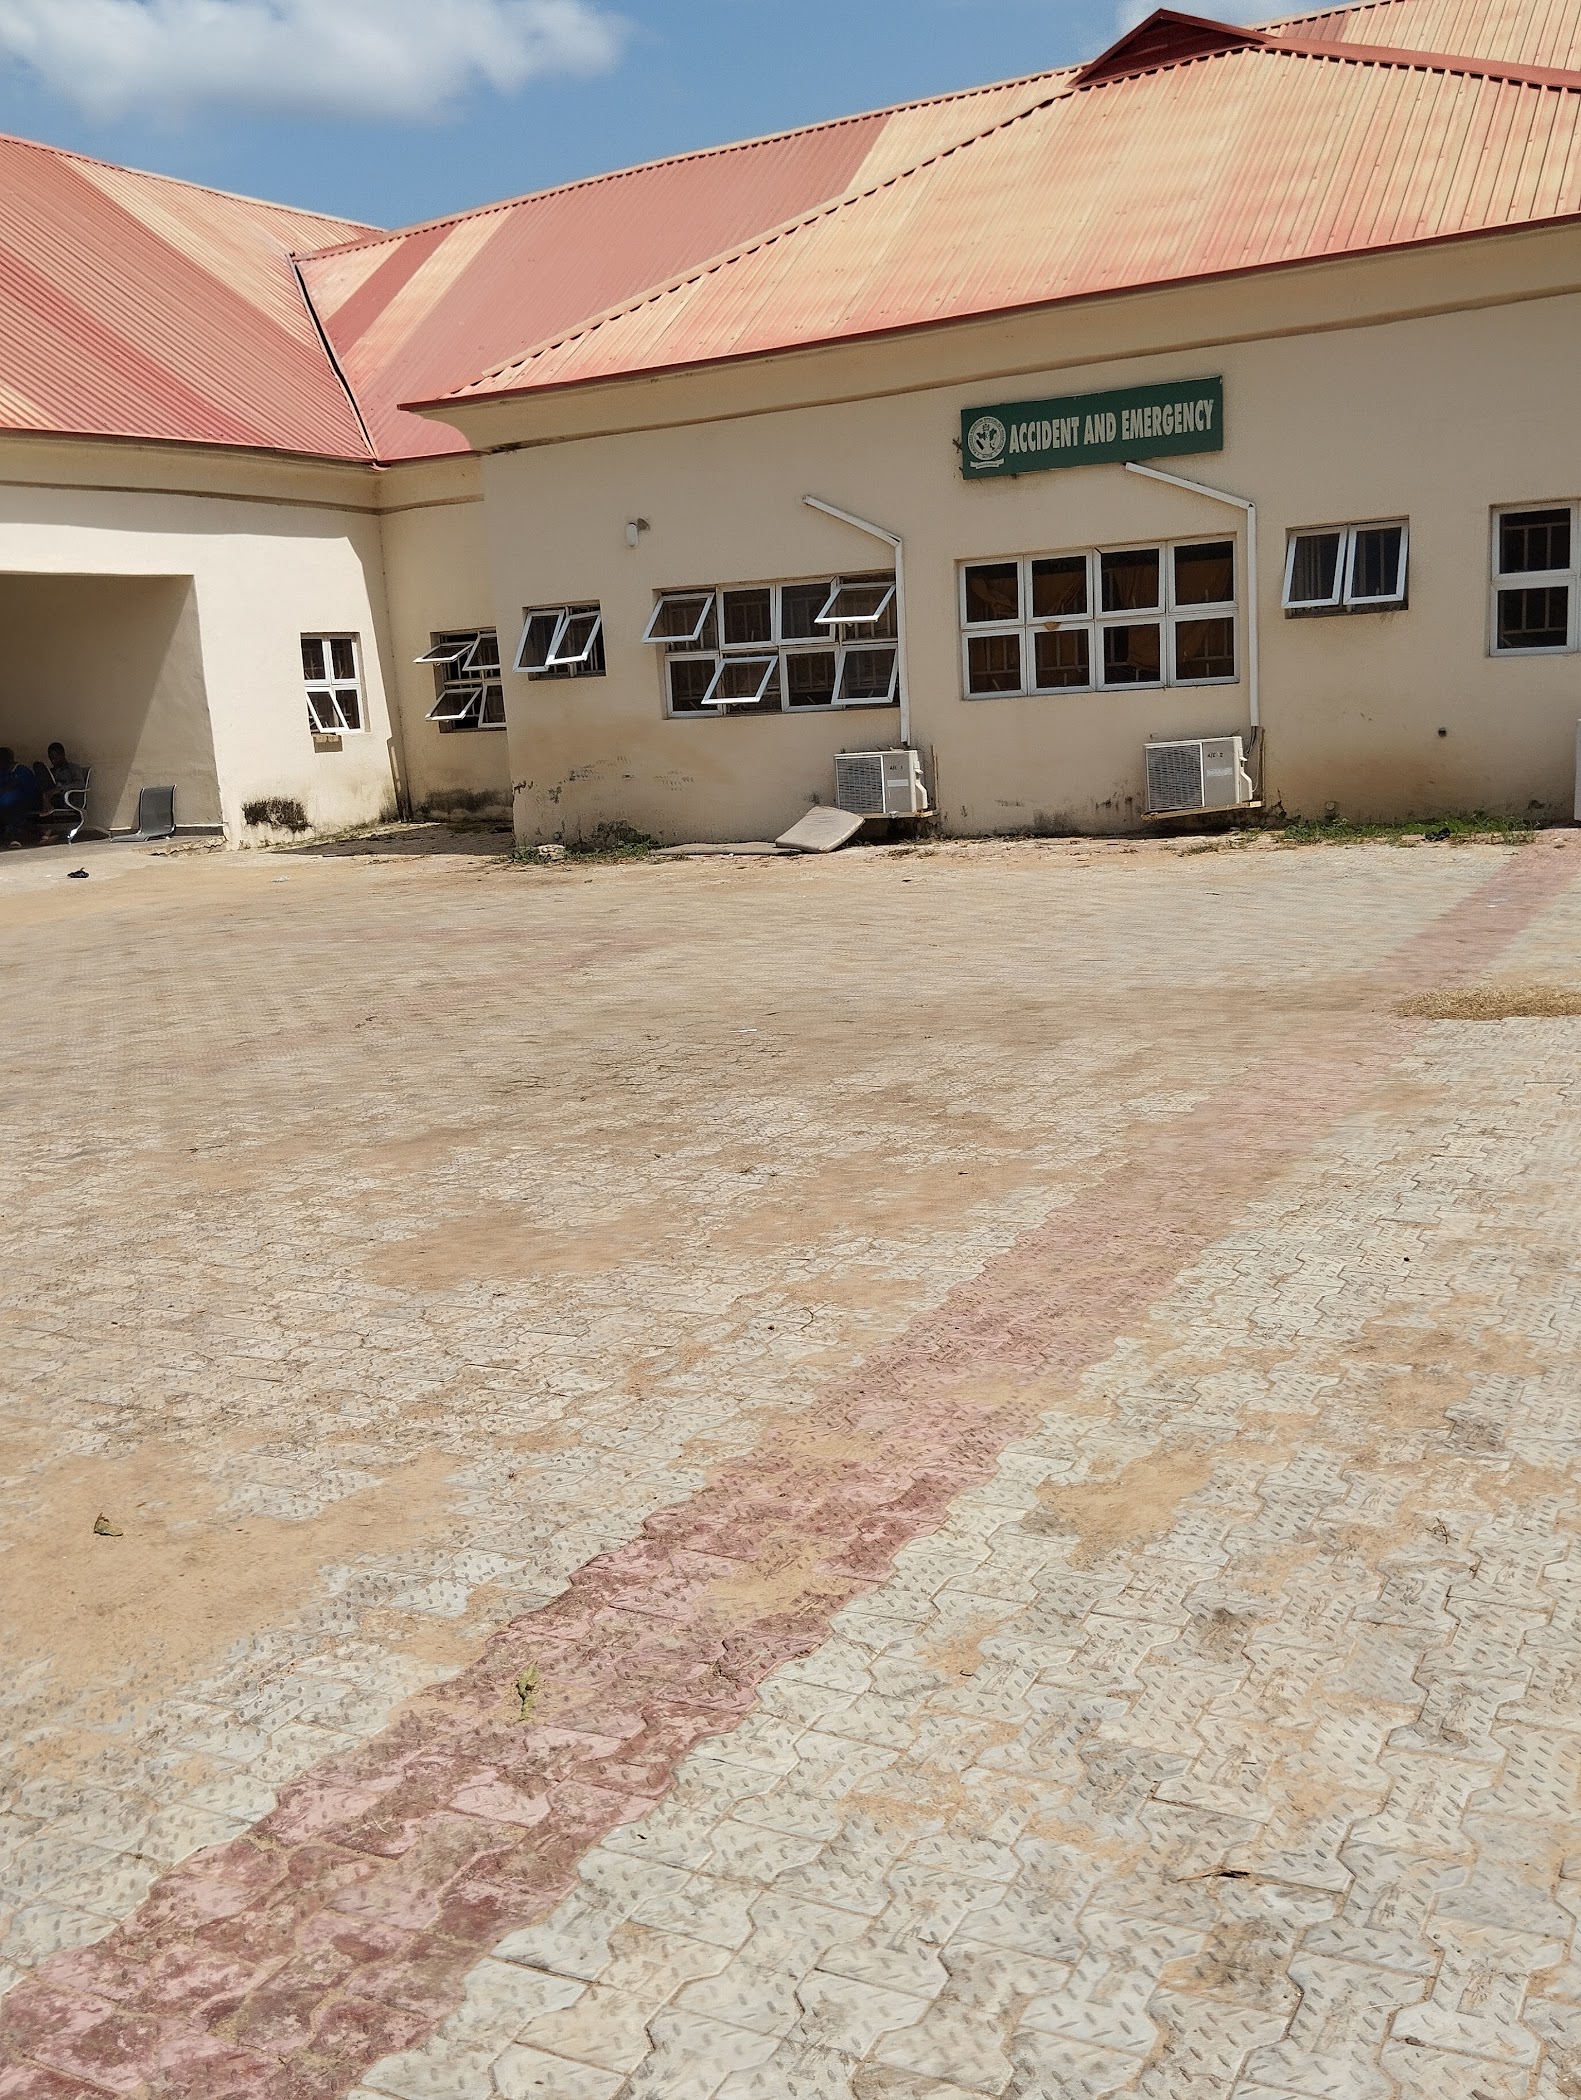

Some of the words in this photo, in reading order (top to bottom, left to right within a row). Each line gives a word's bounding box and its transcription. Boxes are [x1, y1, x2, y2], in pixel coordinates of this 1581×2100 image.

[1009, 416, 1079, 453] ACCIDENT
[1083, 412, 1117, 445] AND
[1121, 399, 1214, 440] EMERGENCY
